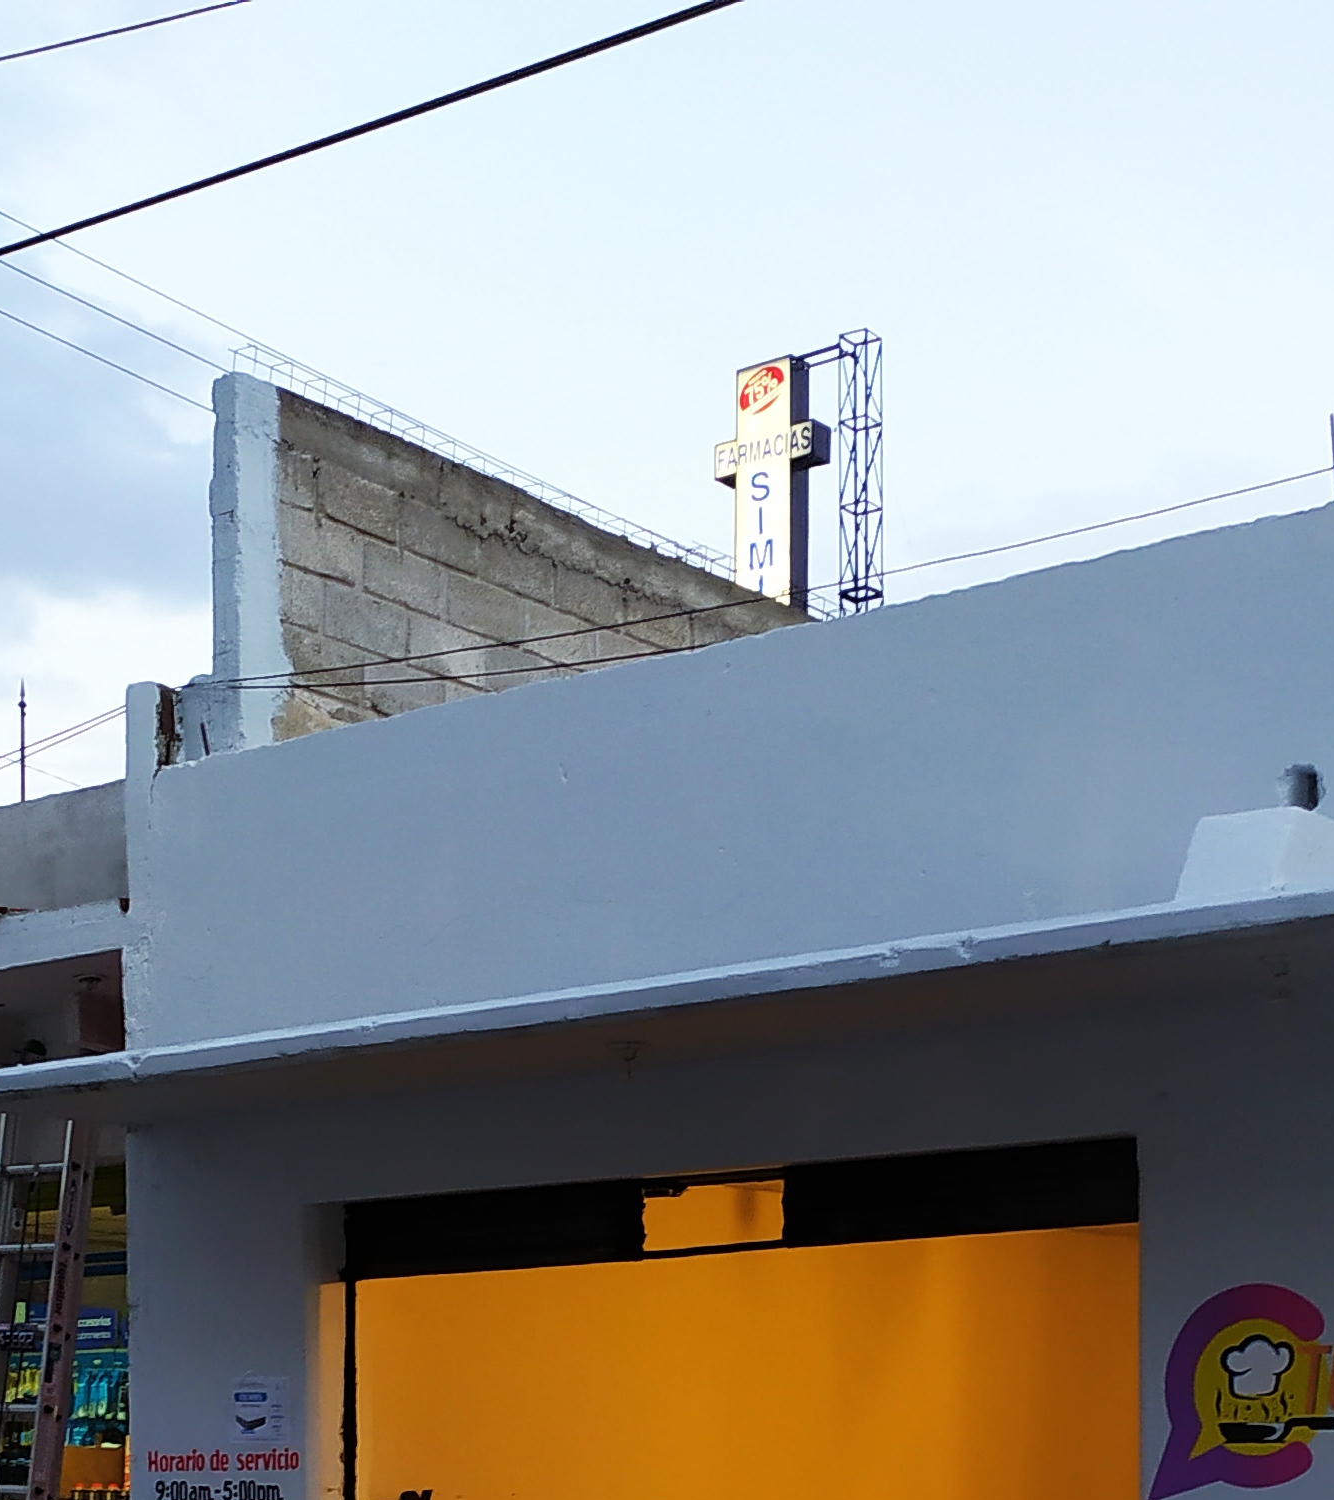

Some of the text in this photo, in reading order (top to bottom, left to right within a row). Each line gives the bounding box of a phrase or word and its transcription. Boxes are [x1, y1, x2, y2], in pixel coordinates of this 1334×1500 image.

[744, 369, 779, 408] 75%
[718, 426, 812, 472] FARMACIAS
[147, 1447, 300, 1472] Horario de servicio
